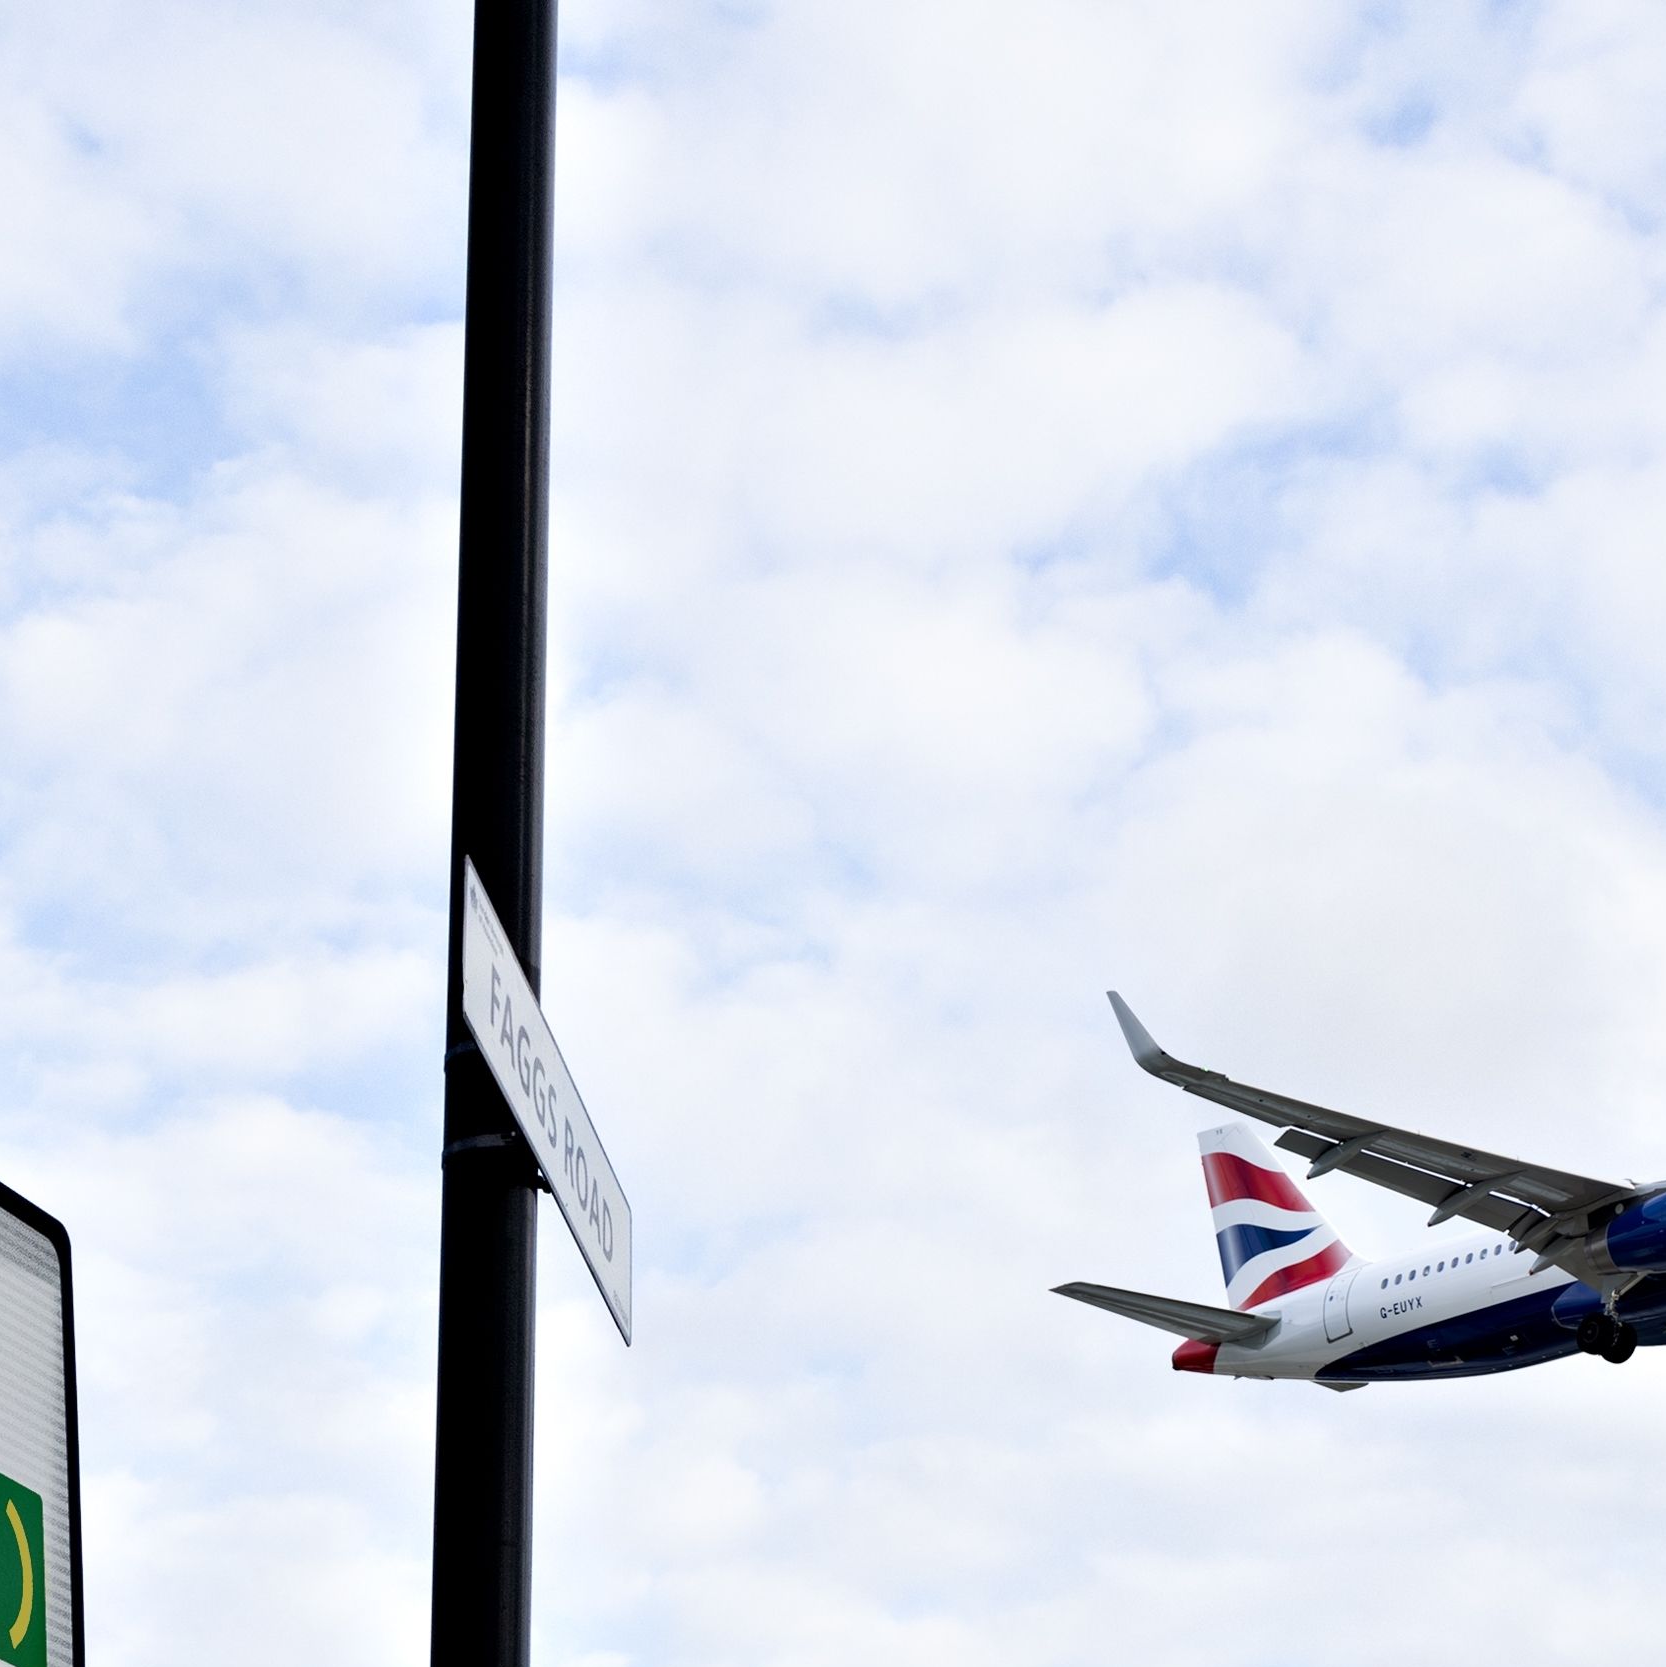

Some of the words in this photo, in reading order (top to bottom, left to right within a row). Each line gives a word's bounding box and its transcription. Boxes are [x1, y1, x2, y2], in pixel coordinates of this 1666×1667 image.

[489, 961, 558, 1150] FAGGS
[564, 1115, 614, 1263] ROAD
[1380, 1296, 1423, 1319] G-EUYX
